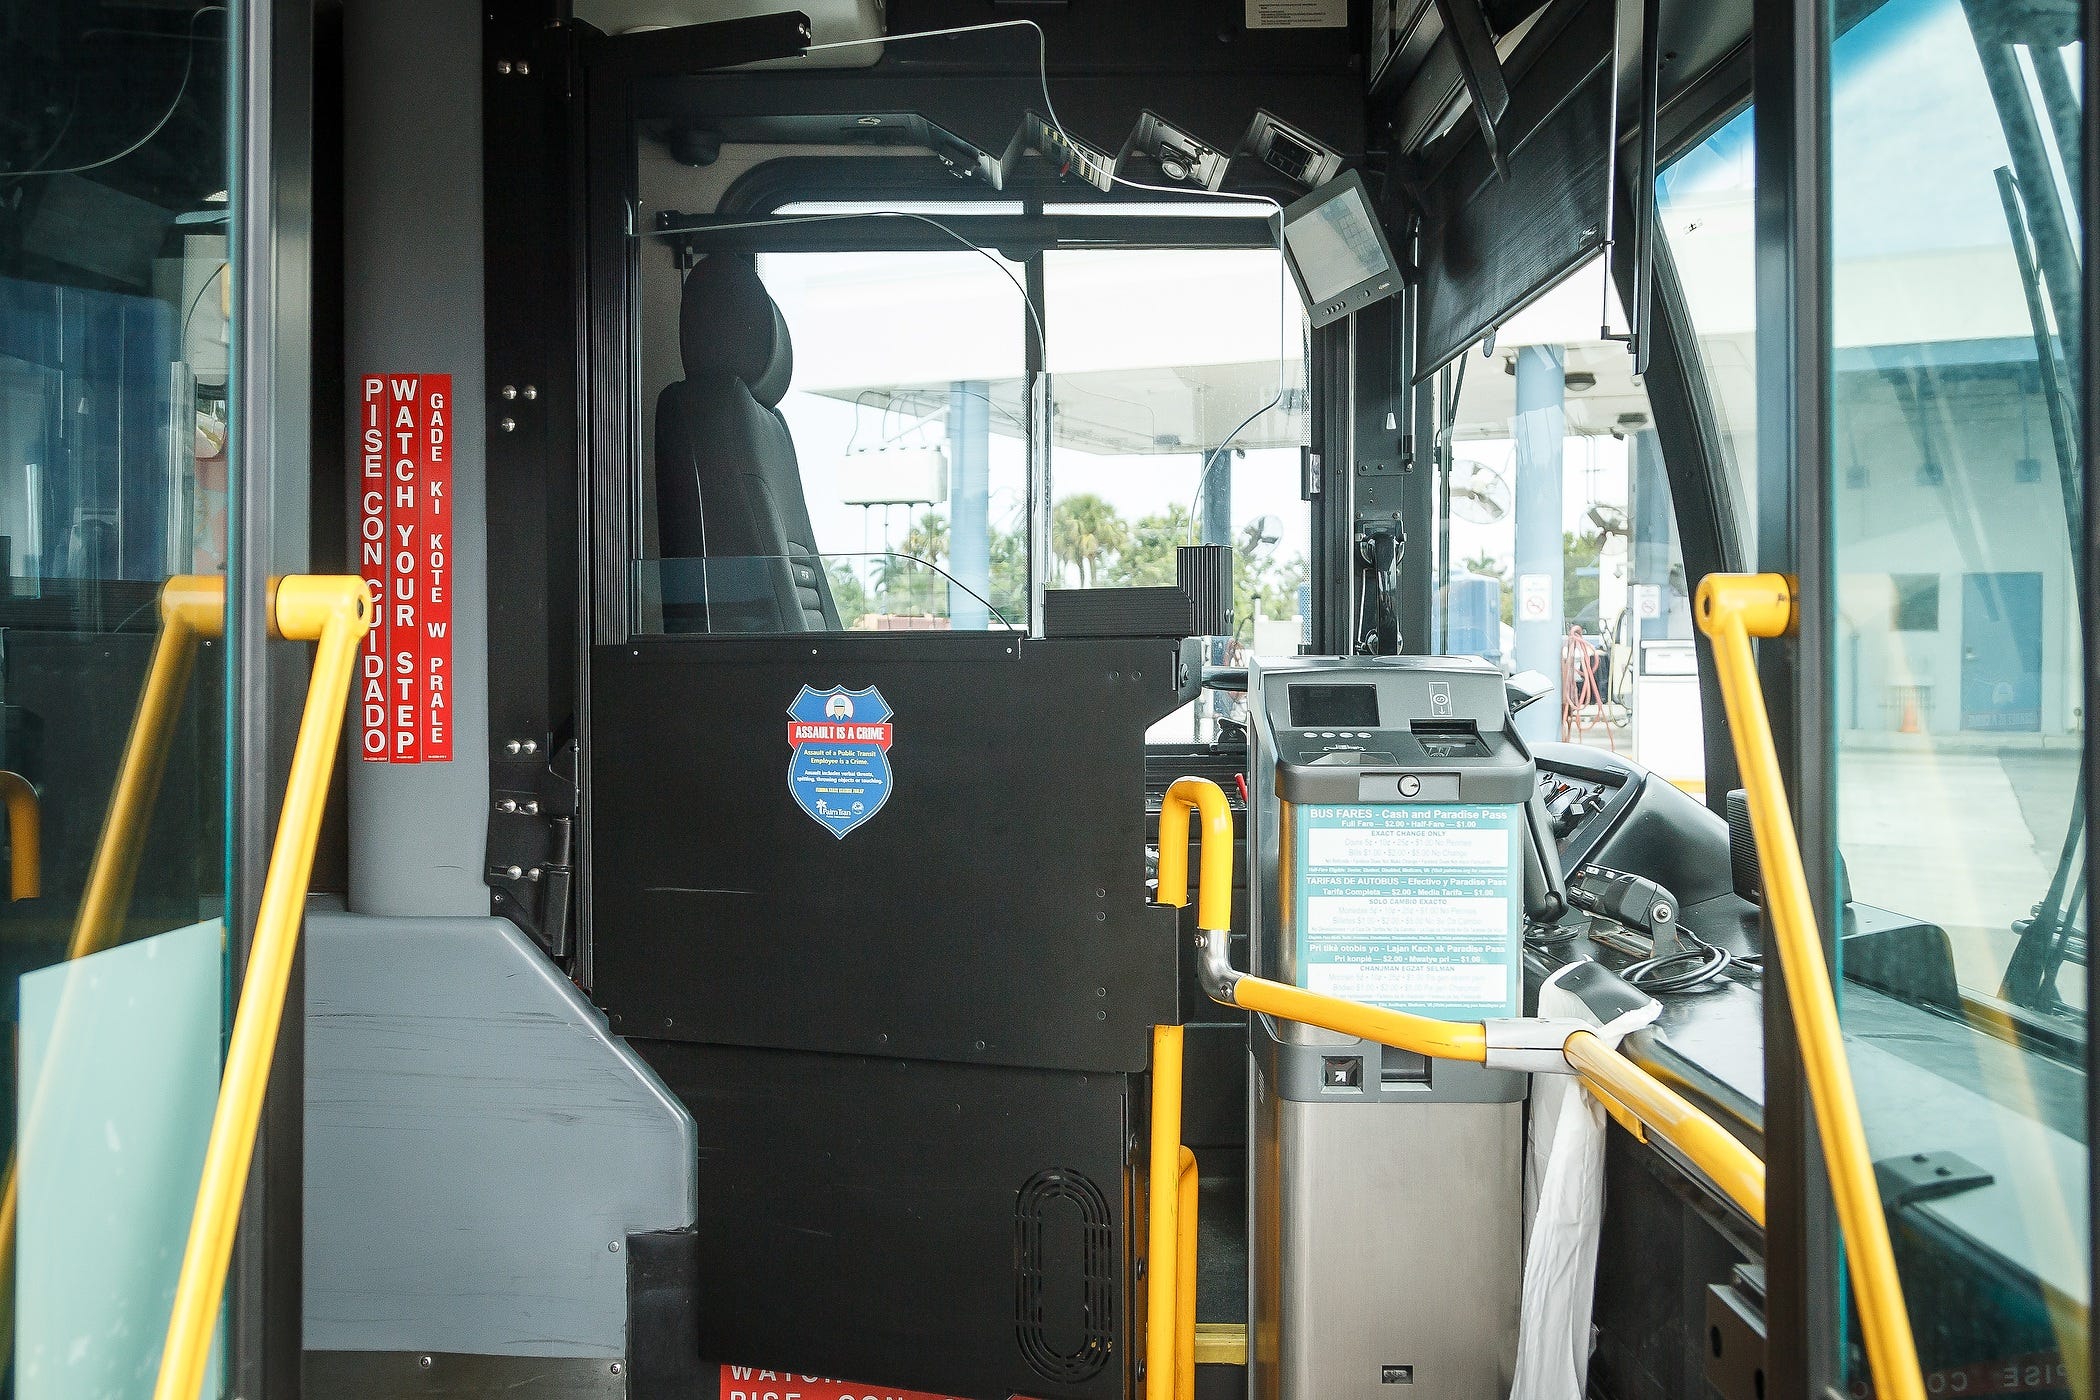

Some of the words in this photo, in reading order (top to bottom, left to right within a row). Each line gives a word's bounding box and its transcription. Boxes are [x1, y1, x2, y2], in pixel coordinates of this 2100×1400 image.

[364, 379, 383, 478] PISE
[430, 393, 444, 462] GADE
[391, 379, 417, 508] WATCH
[430, 481, 443, 515] KI
[363, 491, 384, 565] CON
[396, 525, 414, 627] YOUR
[430, 534, 444, 603] KOTE
[427, 622, 447, 638] W
[364, 579, 386, 754] CUIDADO
[396, 652, 415, 754] STEP
[430, 657, 444, 743] PRALE
[795, 726, 835, 739] ASSAULT
[836, 727, 846, 740] IS
[847, 727, 855, 740] A
[856, 727, 885, 740] CRIME
[810, 758, 838, 766] Employee
[838, 749, 855, 757] Public
[1310, 808, 1333, 818] BUS
[1336, 808, 1372, 818] FARES
[1381, 809, 1408, 819] Cash
[1411, 810, 1431, 819] and
[1434, 810, 1479, 819] Paradise
[1482, 810, 1507, 819] Pass
[1384, 820, 1405, 828] $2.00
[1411, 820, 1445, 828] Half-Fare
[1306, 877, 1342, 885] TARIFAS
[1344, 877, 1357, 885] DE
[1358, 877, 1399, 885] AUTOBUS
[1408, 877, 1441, 885] Efectivo
[1450, 878, 1486, 886] Paradise
[1488, 878, 1507, 886] Pass
[1345, 888, 1380, 896] Completa
[1310, 944, 1321, 952] Pri
[1340, 944, 1366, 952] otobis
[1368, 945, 1379, 953] yo
[1387, 944, 1409, 953] Lajan
[1447, 945, 1483, 953] Paradise
[1485, 945, 1505, 953] Pass
[1382, 955, 1403, 963] $2.00
